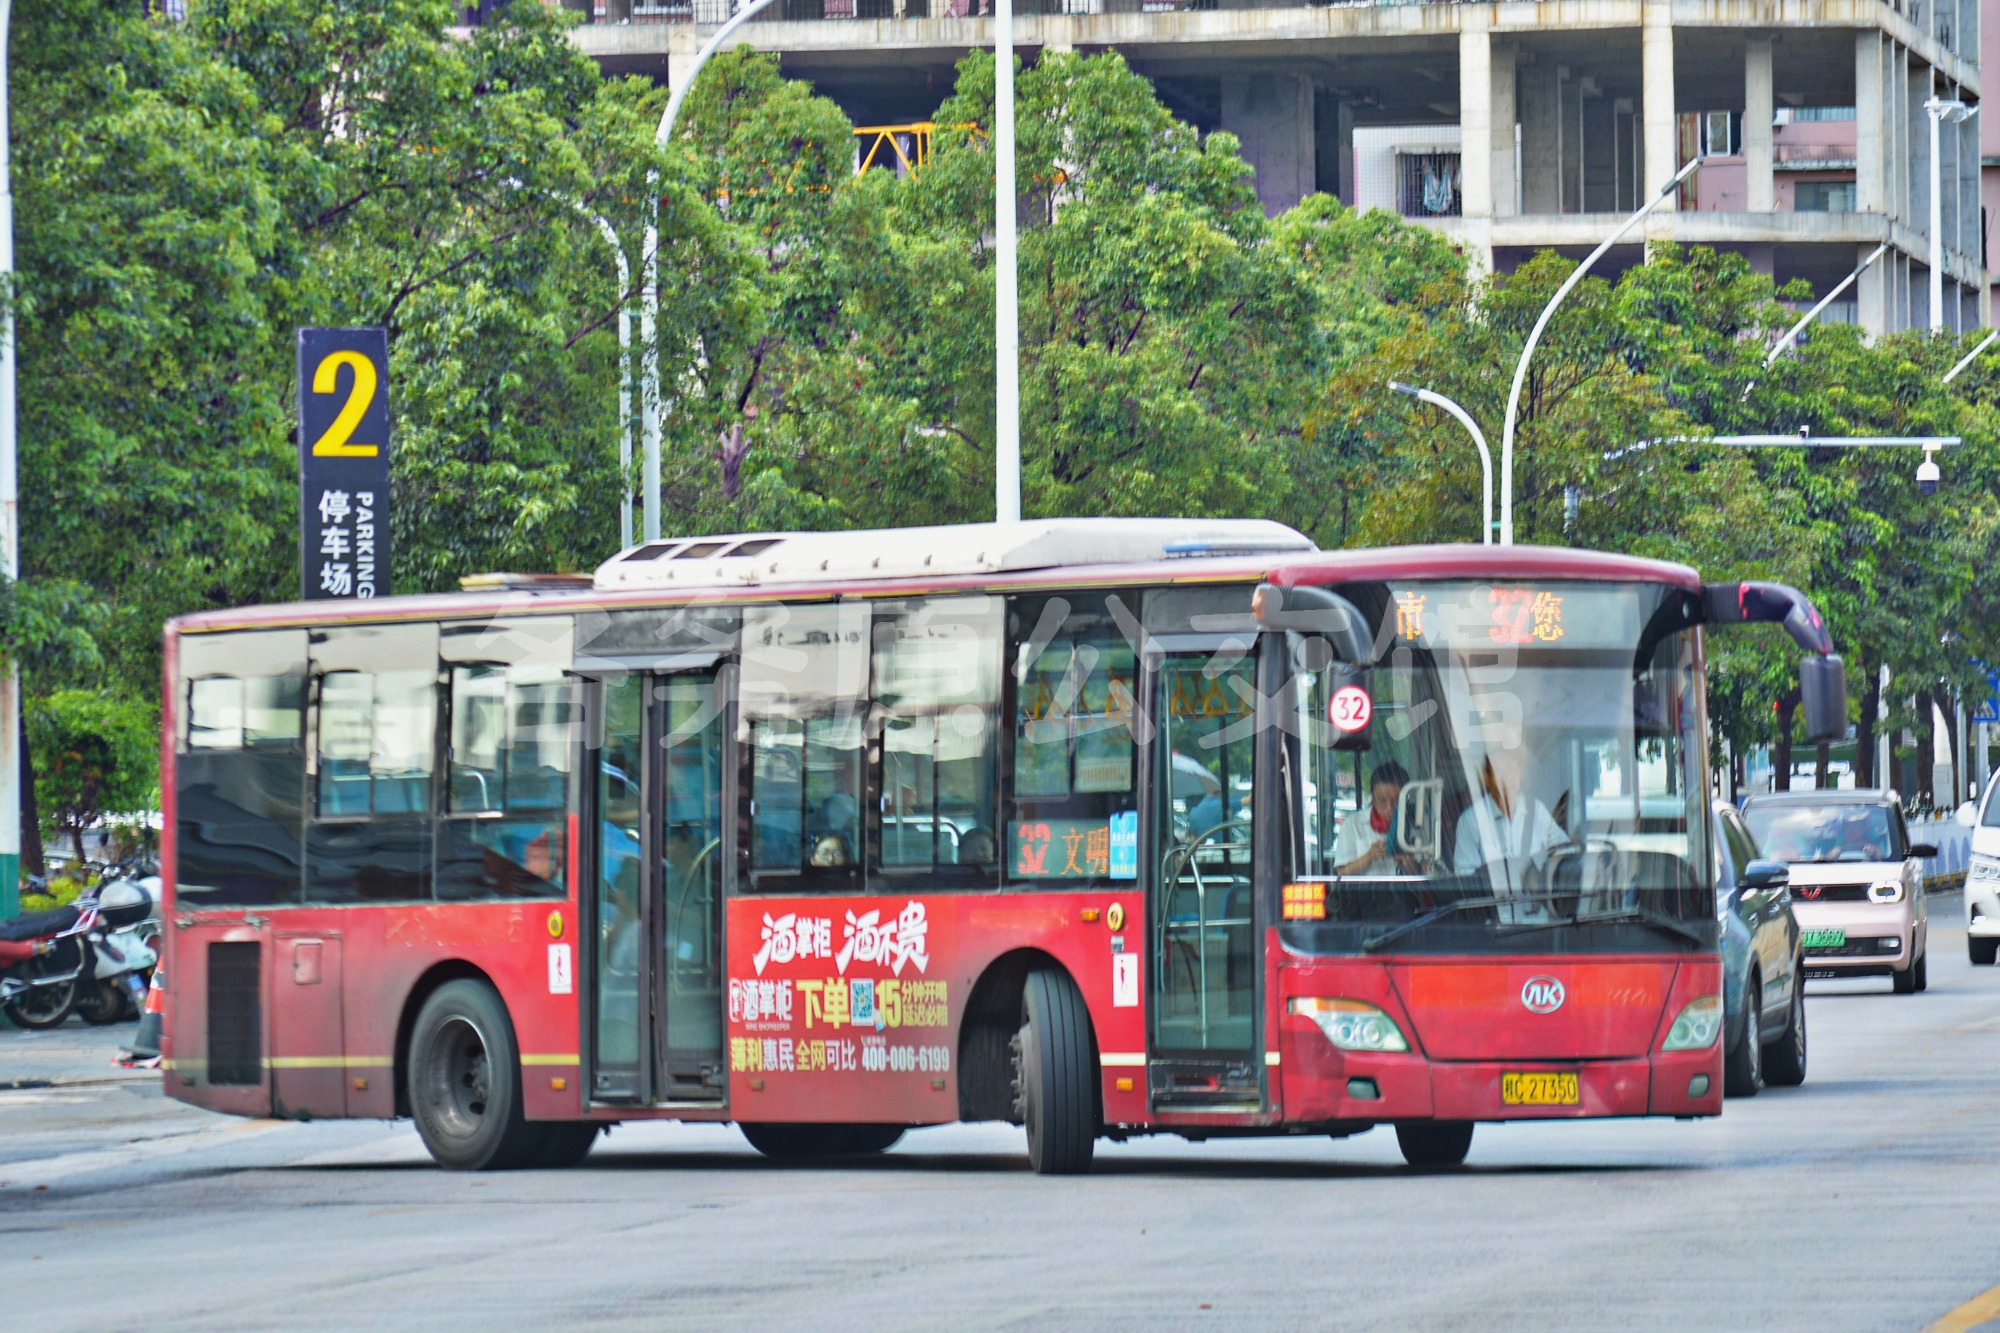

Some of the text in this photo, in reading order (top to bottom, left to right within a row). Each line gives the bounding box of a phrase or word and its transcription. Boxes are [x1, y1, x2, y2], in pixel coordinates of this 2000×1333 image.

[312, 350, 378, 457] 2
[318, 489, 351, 596] 停车场
[355, 491, 375, 599] PARKING
[1396, 588, 1564, 643] 市 32 您
[1338, 696, 1365, 720] 32
[1018, 823, 1108, 874] 32 文明
[753, 900, 929, 977] 酒掌柜 酒不贵
[742, 979, 793, 1021] 酒掌柜
[796, 977, 850, 1029] 下单
[875, 979, 901, 1028] 15
[861, 1045, 950, 1072] 400-006-6199
